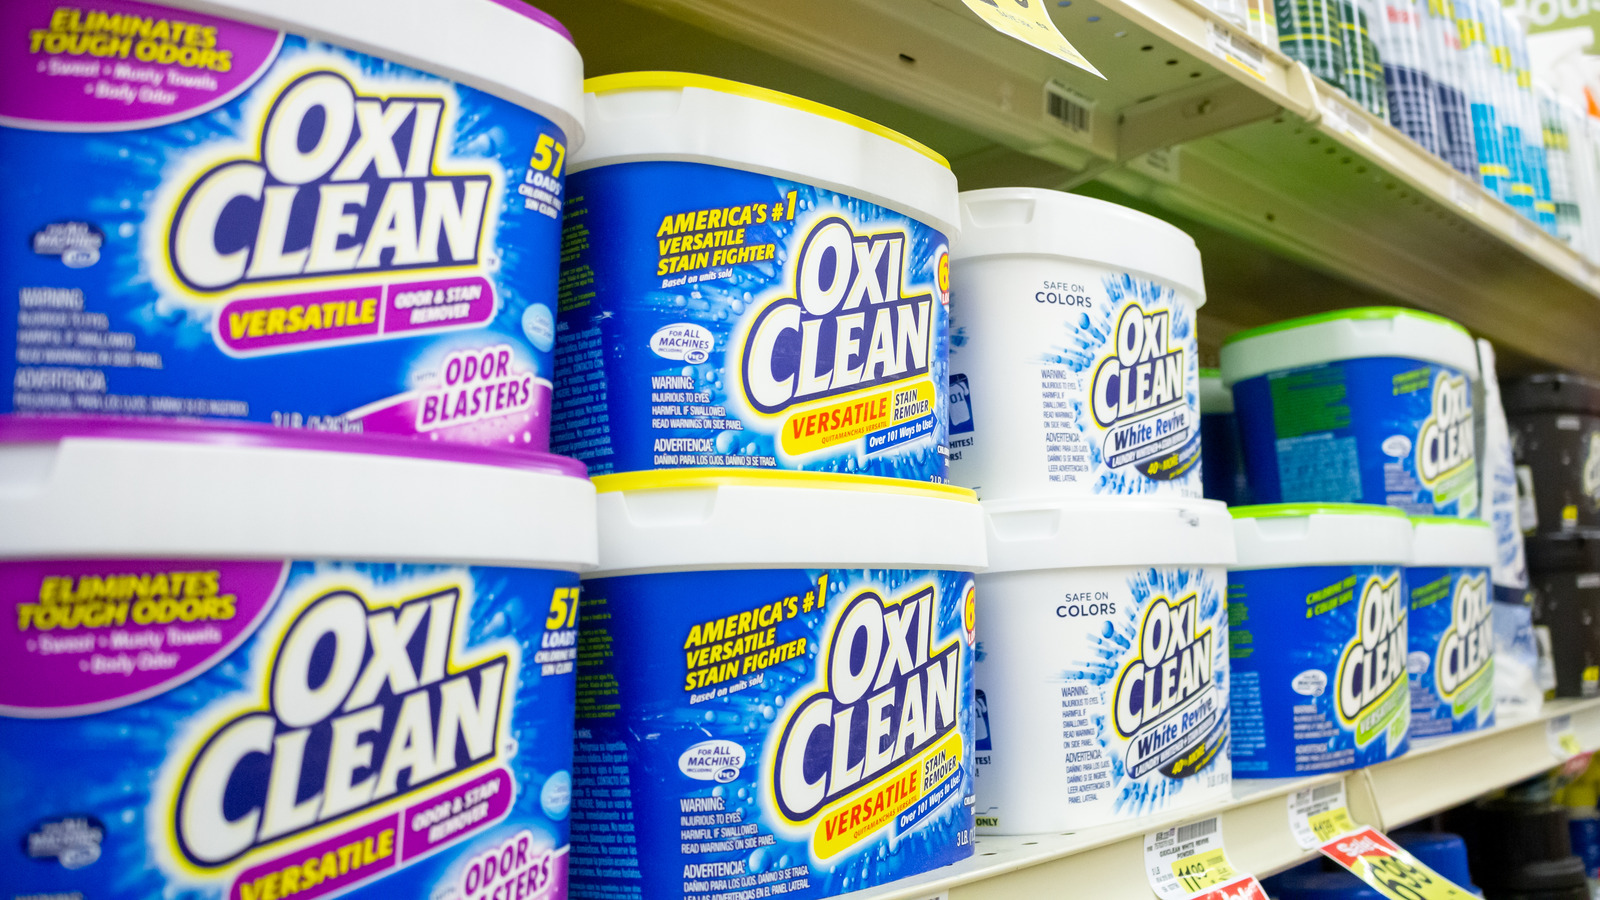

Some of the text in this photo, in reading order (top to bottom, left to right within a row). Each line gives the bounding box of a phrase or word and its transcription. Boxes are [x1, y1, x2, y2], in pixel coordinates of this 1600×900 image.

[50, 8, 217, 49] ELIMINATES
[29, 30, 233, 72] TOUGH ODORS
[264, 73, 445, 185] OXI
[530, 133, 565, 178] 57
[174, 161, 491, 288] CLEAN
[656, 190, 798, 238] AMERICA'S #1
[657, 243, 776, 276] STAIN FIGHTER
[659, 228, 745, 256] VERSATILE
[661, 268, 733, 289] Based on units sold
[800, 222, 903, 316] OXI
[1043, 280, 1085, 293] SAFE ON
[395, 290, 433, 310] ODOR
[447, 284, 482, 302] STAIN
[410, 302, 471, 325] REMOVER
[1035, 291, 1092, 308] COLORS
[229, 299, 378, 339] VERSATILE
[683, 329, 700, 339] ALL
[1117, 305, 1168, 368] OXI
[658, 337, 709, 350] MACHINES
[747, 300, 931, 407] CLEAN
[446, 350, 510, 387] ODOR
[651, 376, 694, 390] WARNING:
[421, 377, 531, 426] BLASTERS
[652, 392, 685, 403] INJURIOUS
[685, 392, 693, 403] TO
[895, 389, 918, 407] STAIN
[1093, 352, 1183, 424] CLEAN
[652, 405, 682, 416] HARMFUL
[683, 405, 690, 416] IF
[652, 418, 670, 429] READ
[670, 419, 702, 429] WARNINGS
[703, 419, 712, 430] ON
[712, 419, 725, 430] SIDE
[792, 397, 888, 439] VERSATILE
[893, 400, 929, 421] REMOVER
[653, 438, 713, 452] ADVERTENCIA:
[821, 427, 865, 444] QUITAMANCHAS
[869, 417, 934, 448] Over 101 Ways to Use!
[1114, 412, 1185, 451] White Revive
[679, 455, 695, 466] PARA
[696, 455, 709, 466] LOS
[745, 456, 752, 466] SI
[752, 456, 759, 466] SE
[40, 570, 220, 606] ELIMINATES
[1065, 591, 1109, 603] SAFE ON
[17, 594, 236, 631] TOUGH ODORS
[546, 587, 580, 630] 57
[684, 574, 828, 650] AMERICA'S #1
[1056, 603, 1116, 618] COLORS
[1361, 579, 1399, 651] OXI
[686, 627, 776, 670] VERSATILE
[831, 592, 932, 706] OXI
[1142, 597, 1196, 668] OXI
[274, 591, 458, 728] OXI
[685, 637, 807, 691] STAIN FIGHTER
[1341, 613, 1407, 718] CLEAN
[690, 673, 764, 705] Based on units sold
[1116, 629, 1211, 733] CLEAN
[779, 647, 958, 814] CLEAN
[1138, 697, 1212, 760] White Revive
[182, 662, 506, 863] CLEAN
[687, 756, 741, 767] MACHINES
[698, 746, 731, 756] FOR ALL
[925, 749, 946, 775] STAIN
[923, 755, 957, 791] REMOVER
[680, 797, 725, 812] WARNING:
[825, 770, 918, 842] VERSATILE
[900, 771, 961, 828] Over 101 Ways to Use!
[680, 815, 715, 827] INJURIOUS
[716, 814, 724, 825] TO
[681, 829, 712, 840] HARMFUL
[713, 828, 720, 838] IF
[853, 808, 896, 839] QUITAMANCHAS
[976, 817, 998, 827] ONLY
[681, 843, 699, 854] READ
[700, 840, 734, 854] WARNINGS
[734, 838, 745, 849] ON
[745, 837, 758, 848] SIDE
[956, 831, 961, 847] 3
[240, 829, 395, 900] VERSATILE
[465, 836, 529, 896] ODOR
[480, 855, 550, 900] STERS
[683, 861, 746, 879] ADVERTENCIA:
[710, 880, 727, 891] PARA
[728, 879, 740, 890] LOS
[778, 869, 784, 880] SI
[784, 868, 791, 879] SE
[756, 888, 764, 898] EN
[764, 887, 771, 897] EL
[771, 883, 788, 895] PANEL
